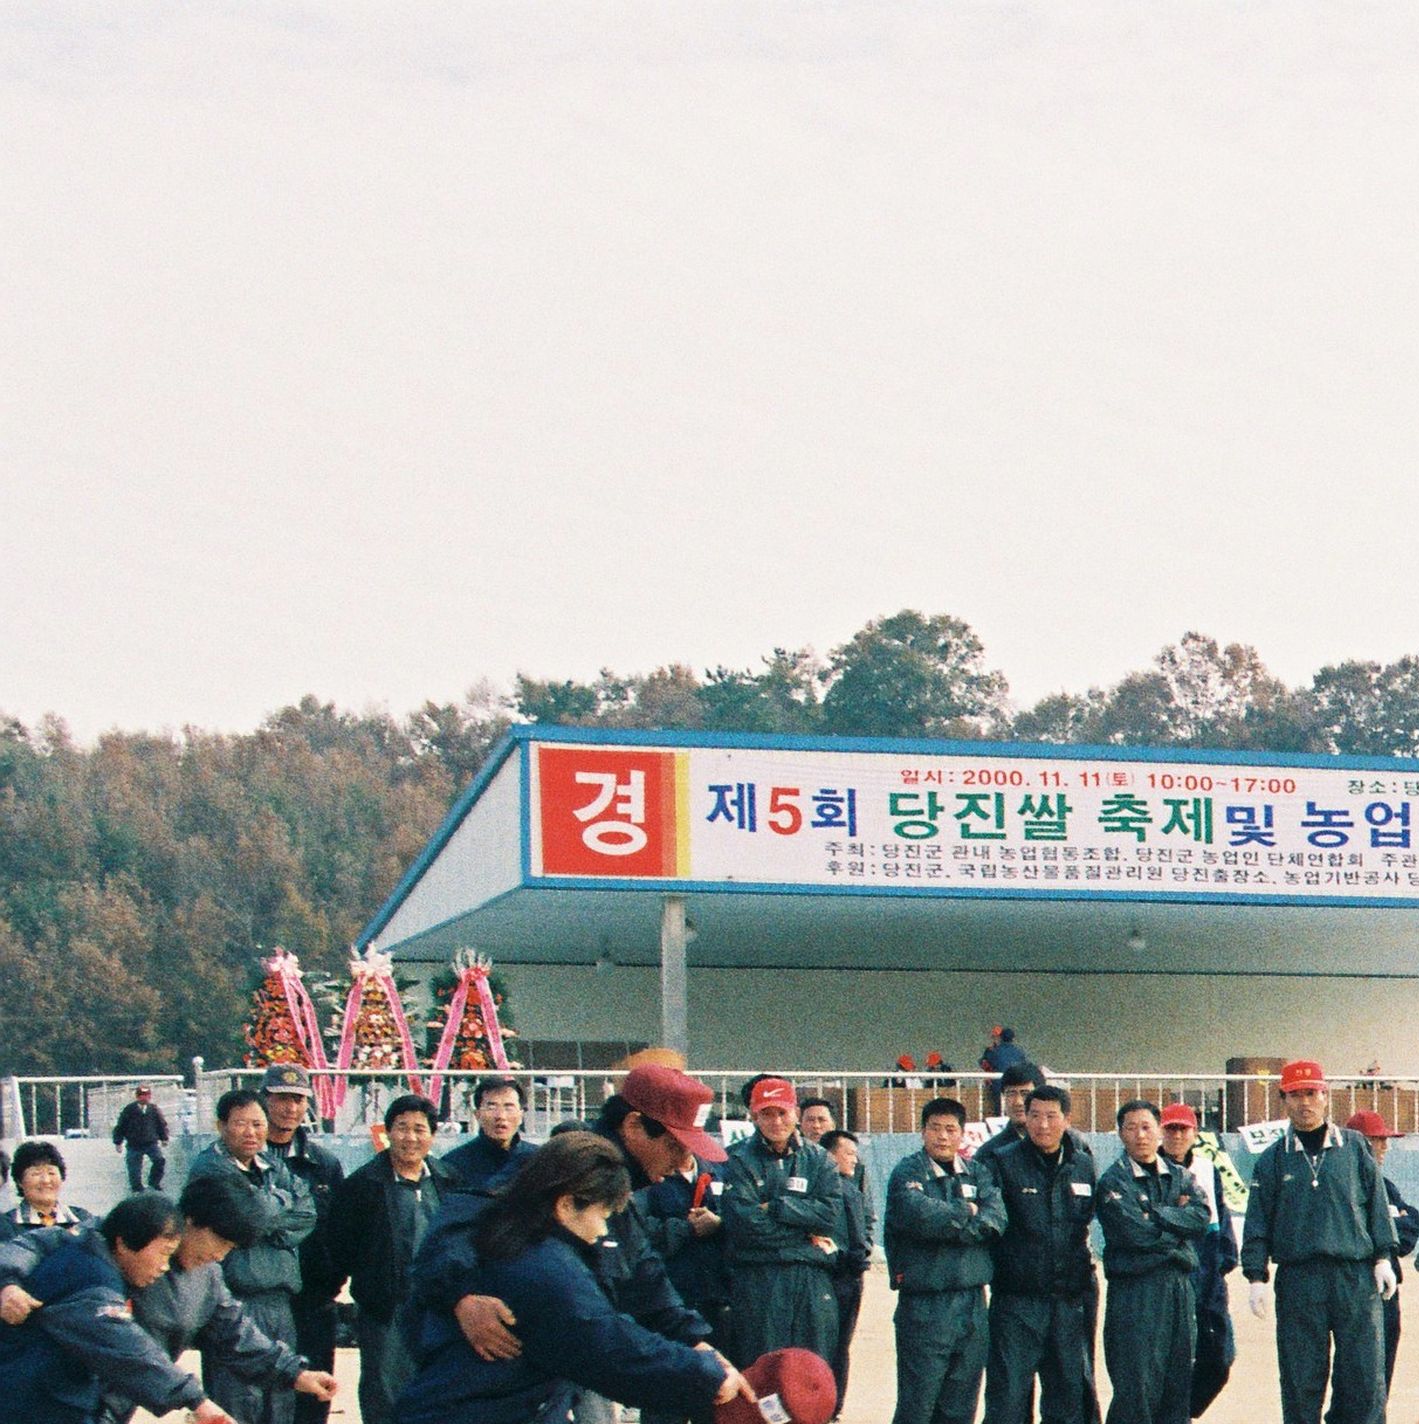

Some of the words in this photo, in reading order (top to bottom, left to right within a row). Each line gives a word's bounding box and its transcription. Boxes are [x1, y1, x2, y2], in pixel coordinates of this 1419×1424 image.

[573, 769, 648, 856] 경
[705, 782, 857, 837] 제5회
[888, 790, 1072, 841] 당진쌀
